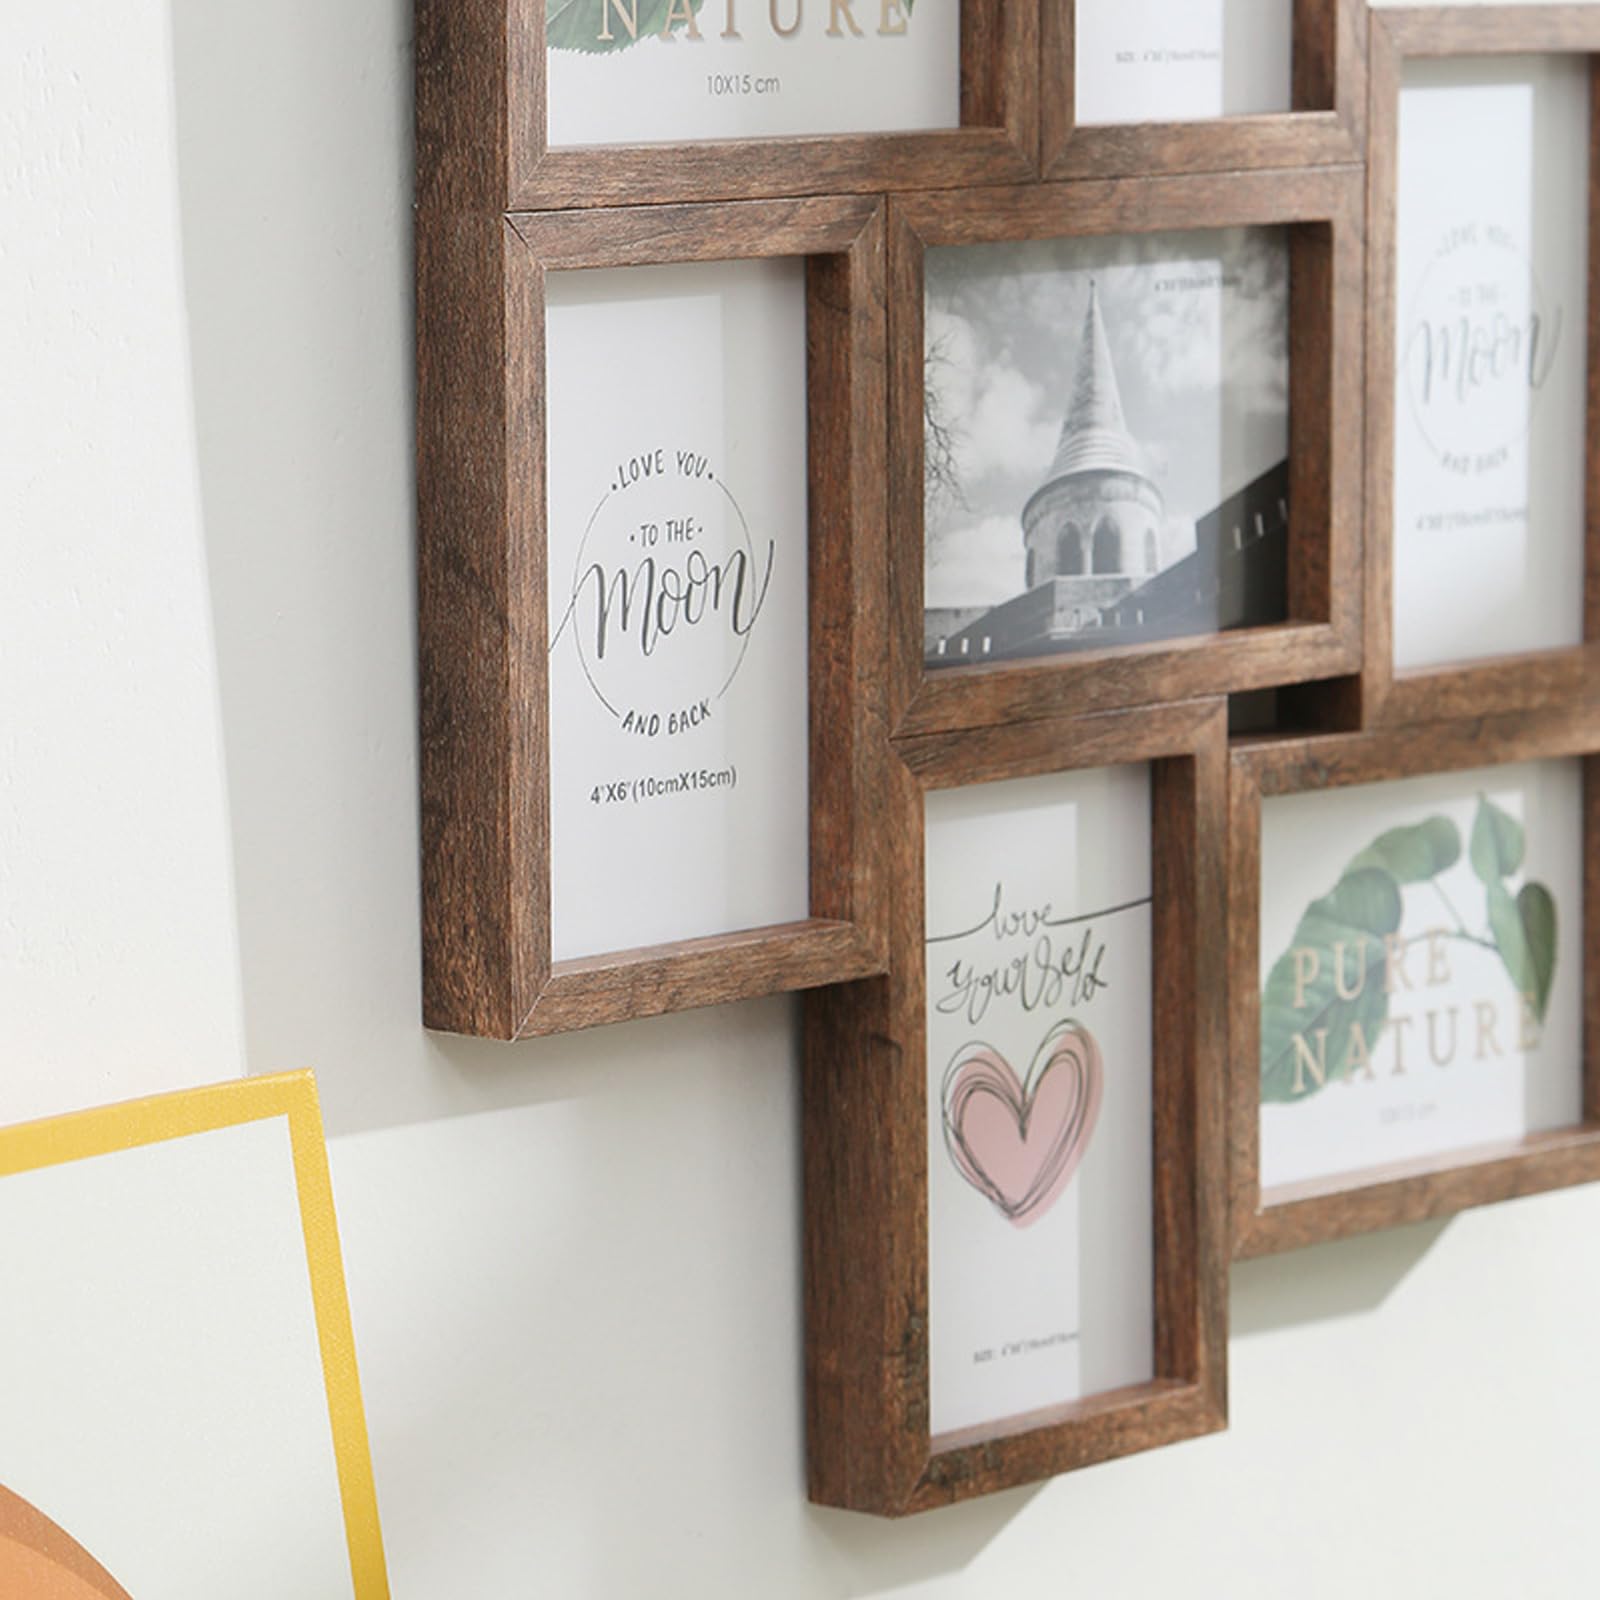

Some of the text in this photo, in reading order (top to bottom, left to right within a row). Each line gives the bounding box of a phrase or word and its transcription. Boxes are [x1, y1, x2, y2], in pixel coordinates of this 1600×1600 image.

[707, 75, 781, 95] 10X15 cm
[618, 449, 708, 489] LOVE YOU
[640, 516, 694, 547] TO THE
[622, 697, 711, 737] AND BACK
[1292, 924, 1452, 1009] PURE
[1290, 991, 1541, 1094] NATURE
